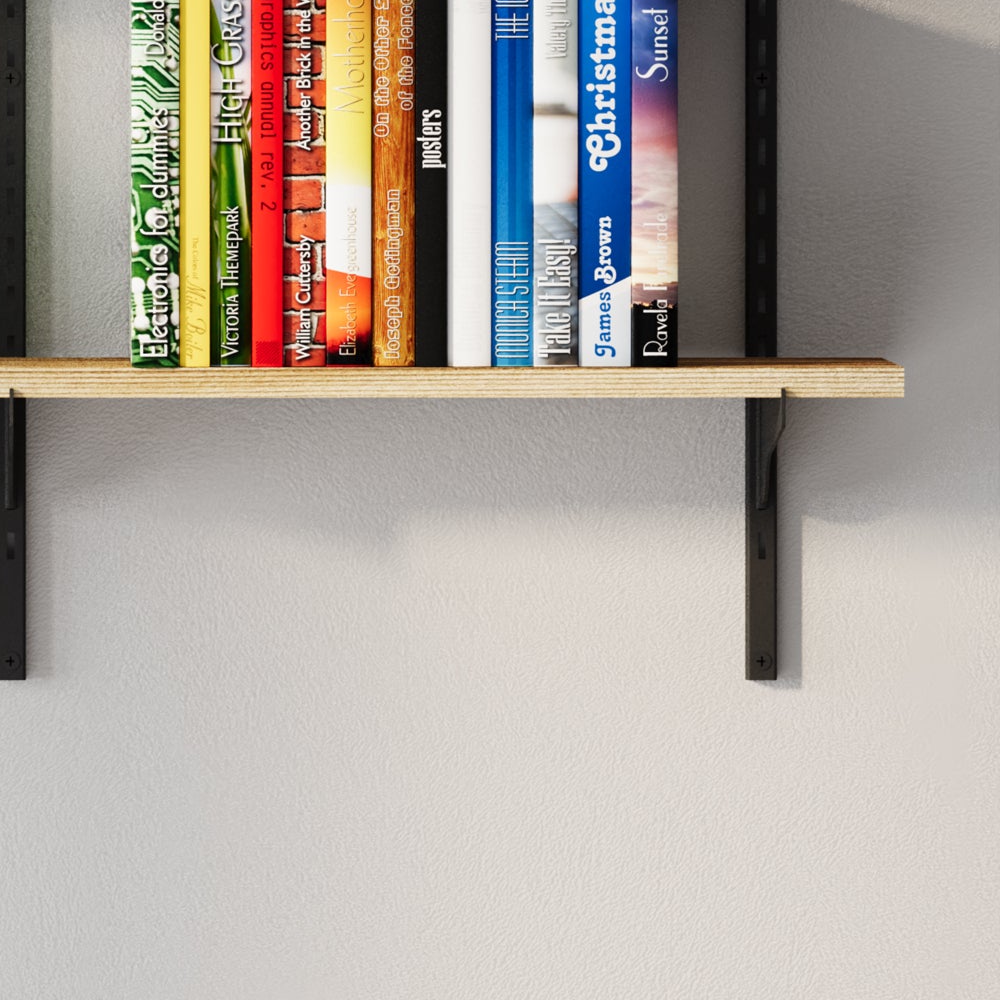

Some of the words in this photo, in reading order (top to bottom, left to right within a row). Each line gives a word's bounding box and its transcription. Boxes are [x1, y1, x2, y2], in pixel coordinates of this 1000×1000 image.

[144, 0, 165, 56] Donald
[296, 9, 312, 34] the
[296, 36, 312, 49] in
[373, 16, 390, 71] Other
[494, 12, 529, 42] THE
[544, 19, 572, 60] Valery
[635, 8, 669, 82] Sunset
[295, 53, 312, 89] Brick
[373, 76, 390, 107] the
[397, 56, 414, 86] the
[259, 81, 278, 139] annual
[295, 93, 312, 151] Another
[373, 112, 390, 138] On
[397, 91, 414, 111] of
[139, 108, 168, 200] dummies
[416, 109, 446, 169] posters
[259, 151, 275, 188] rev.
[139, 208, 168, 236] for
[260, 201, 277, 211] 2
[294, 235, 316, 304] Cuttersby
[338, 207, 360, 297] Evergreenhouse
[495, 241, 529, 295] STEAM
[537, 239, 577, 288] Easy!
[594, 216, 617, 285] Brown
[139, 243, 168, 358] Electronics
[537, 292, 571, 307] It
[594, 291, 616, 358] James
[294, 308, 311, 361] William
[338, 301, 358, 356] Elizabeth
[495, 300, 529, 358] MONICA
[537, 312, 571, 359] Take
[642, 299, 668, 357] Ravela
